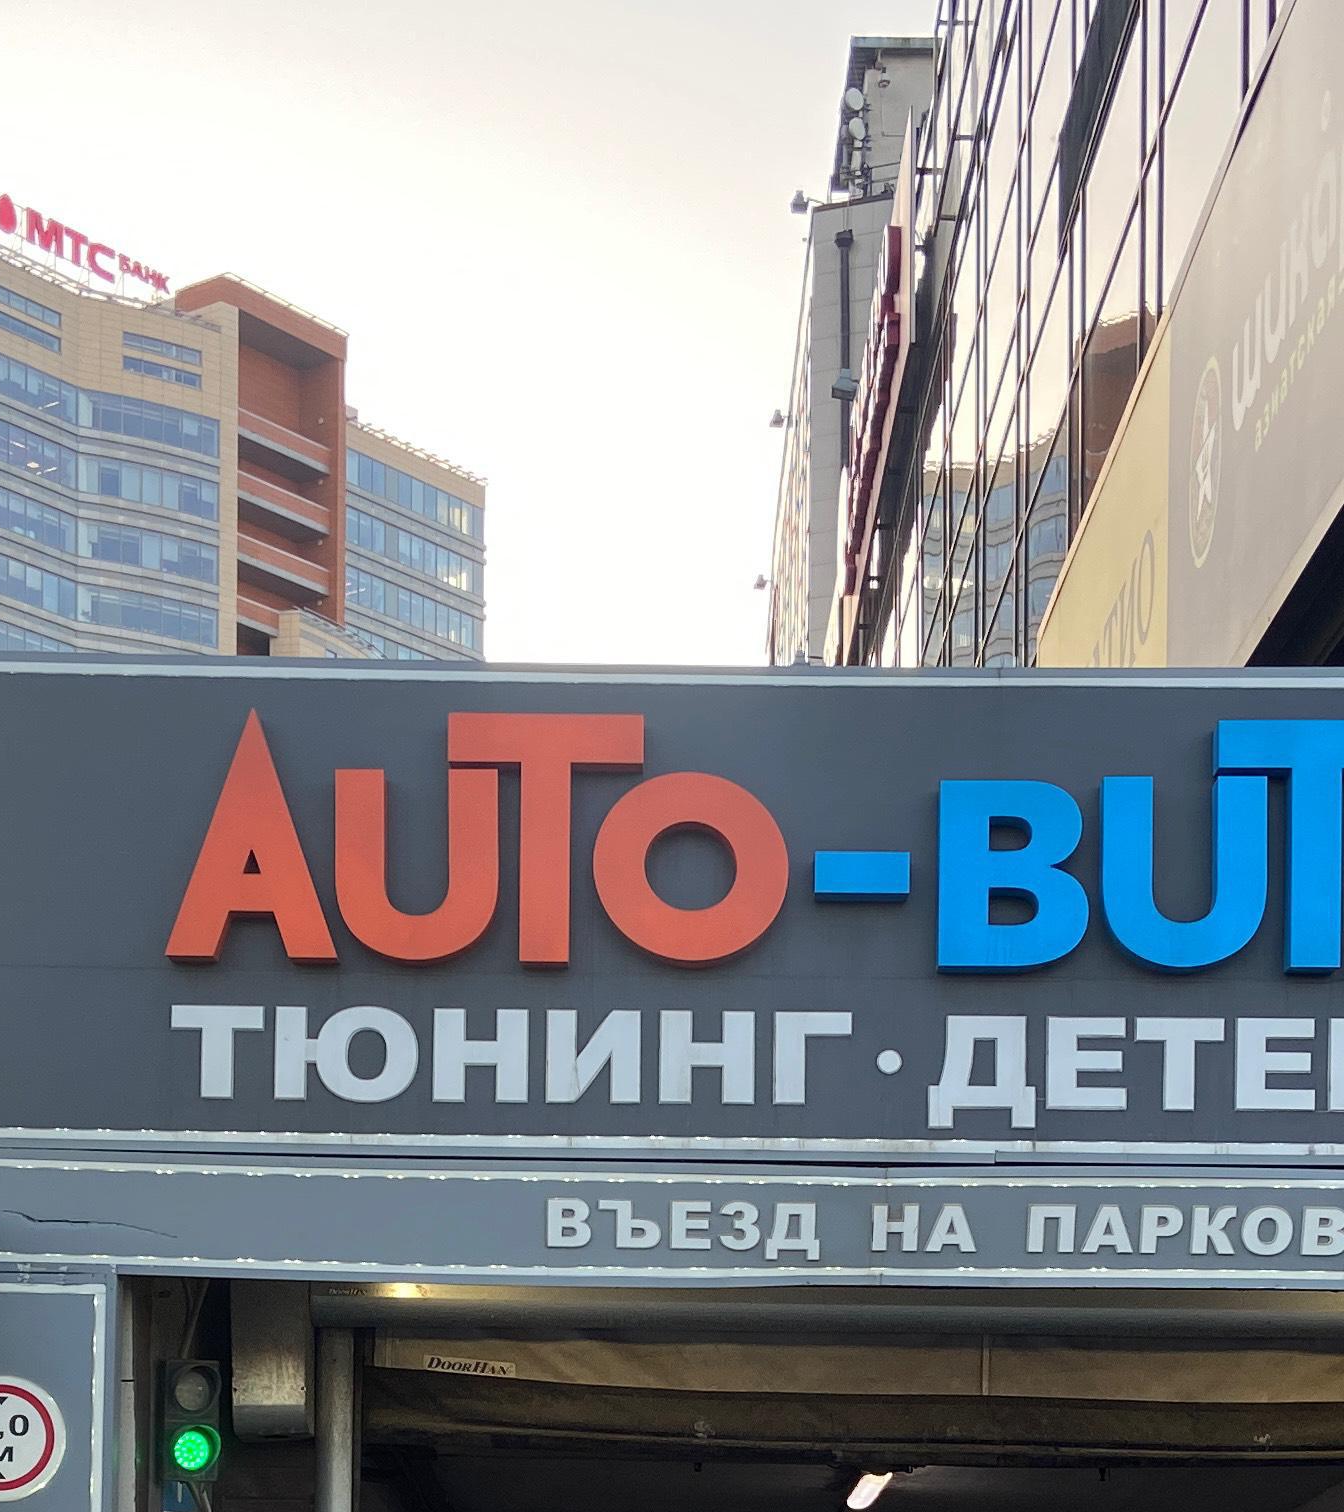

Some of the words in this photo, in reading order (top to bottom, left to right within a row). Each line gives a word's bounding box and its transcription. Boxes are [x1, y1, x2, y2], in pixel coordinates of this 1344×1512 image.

[26, 206, 115, 285] МТС
[119, 252, 170, 295] БАНК
[170, 1003, 853, 1105] ТЮНИНГ
[545, 1197, 821, 1261] ВЪЕЗД
[871, 1203, 978, 1253] НА
